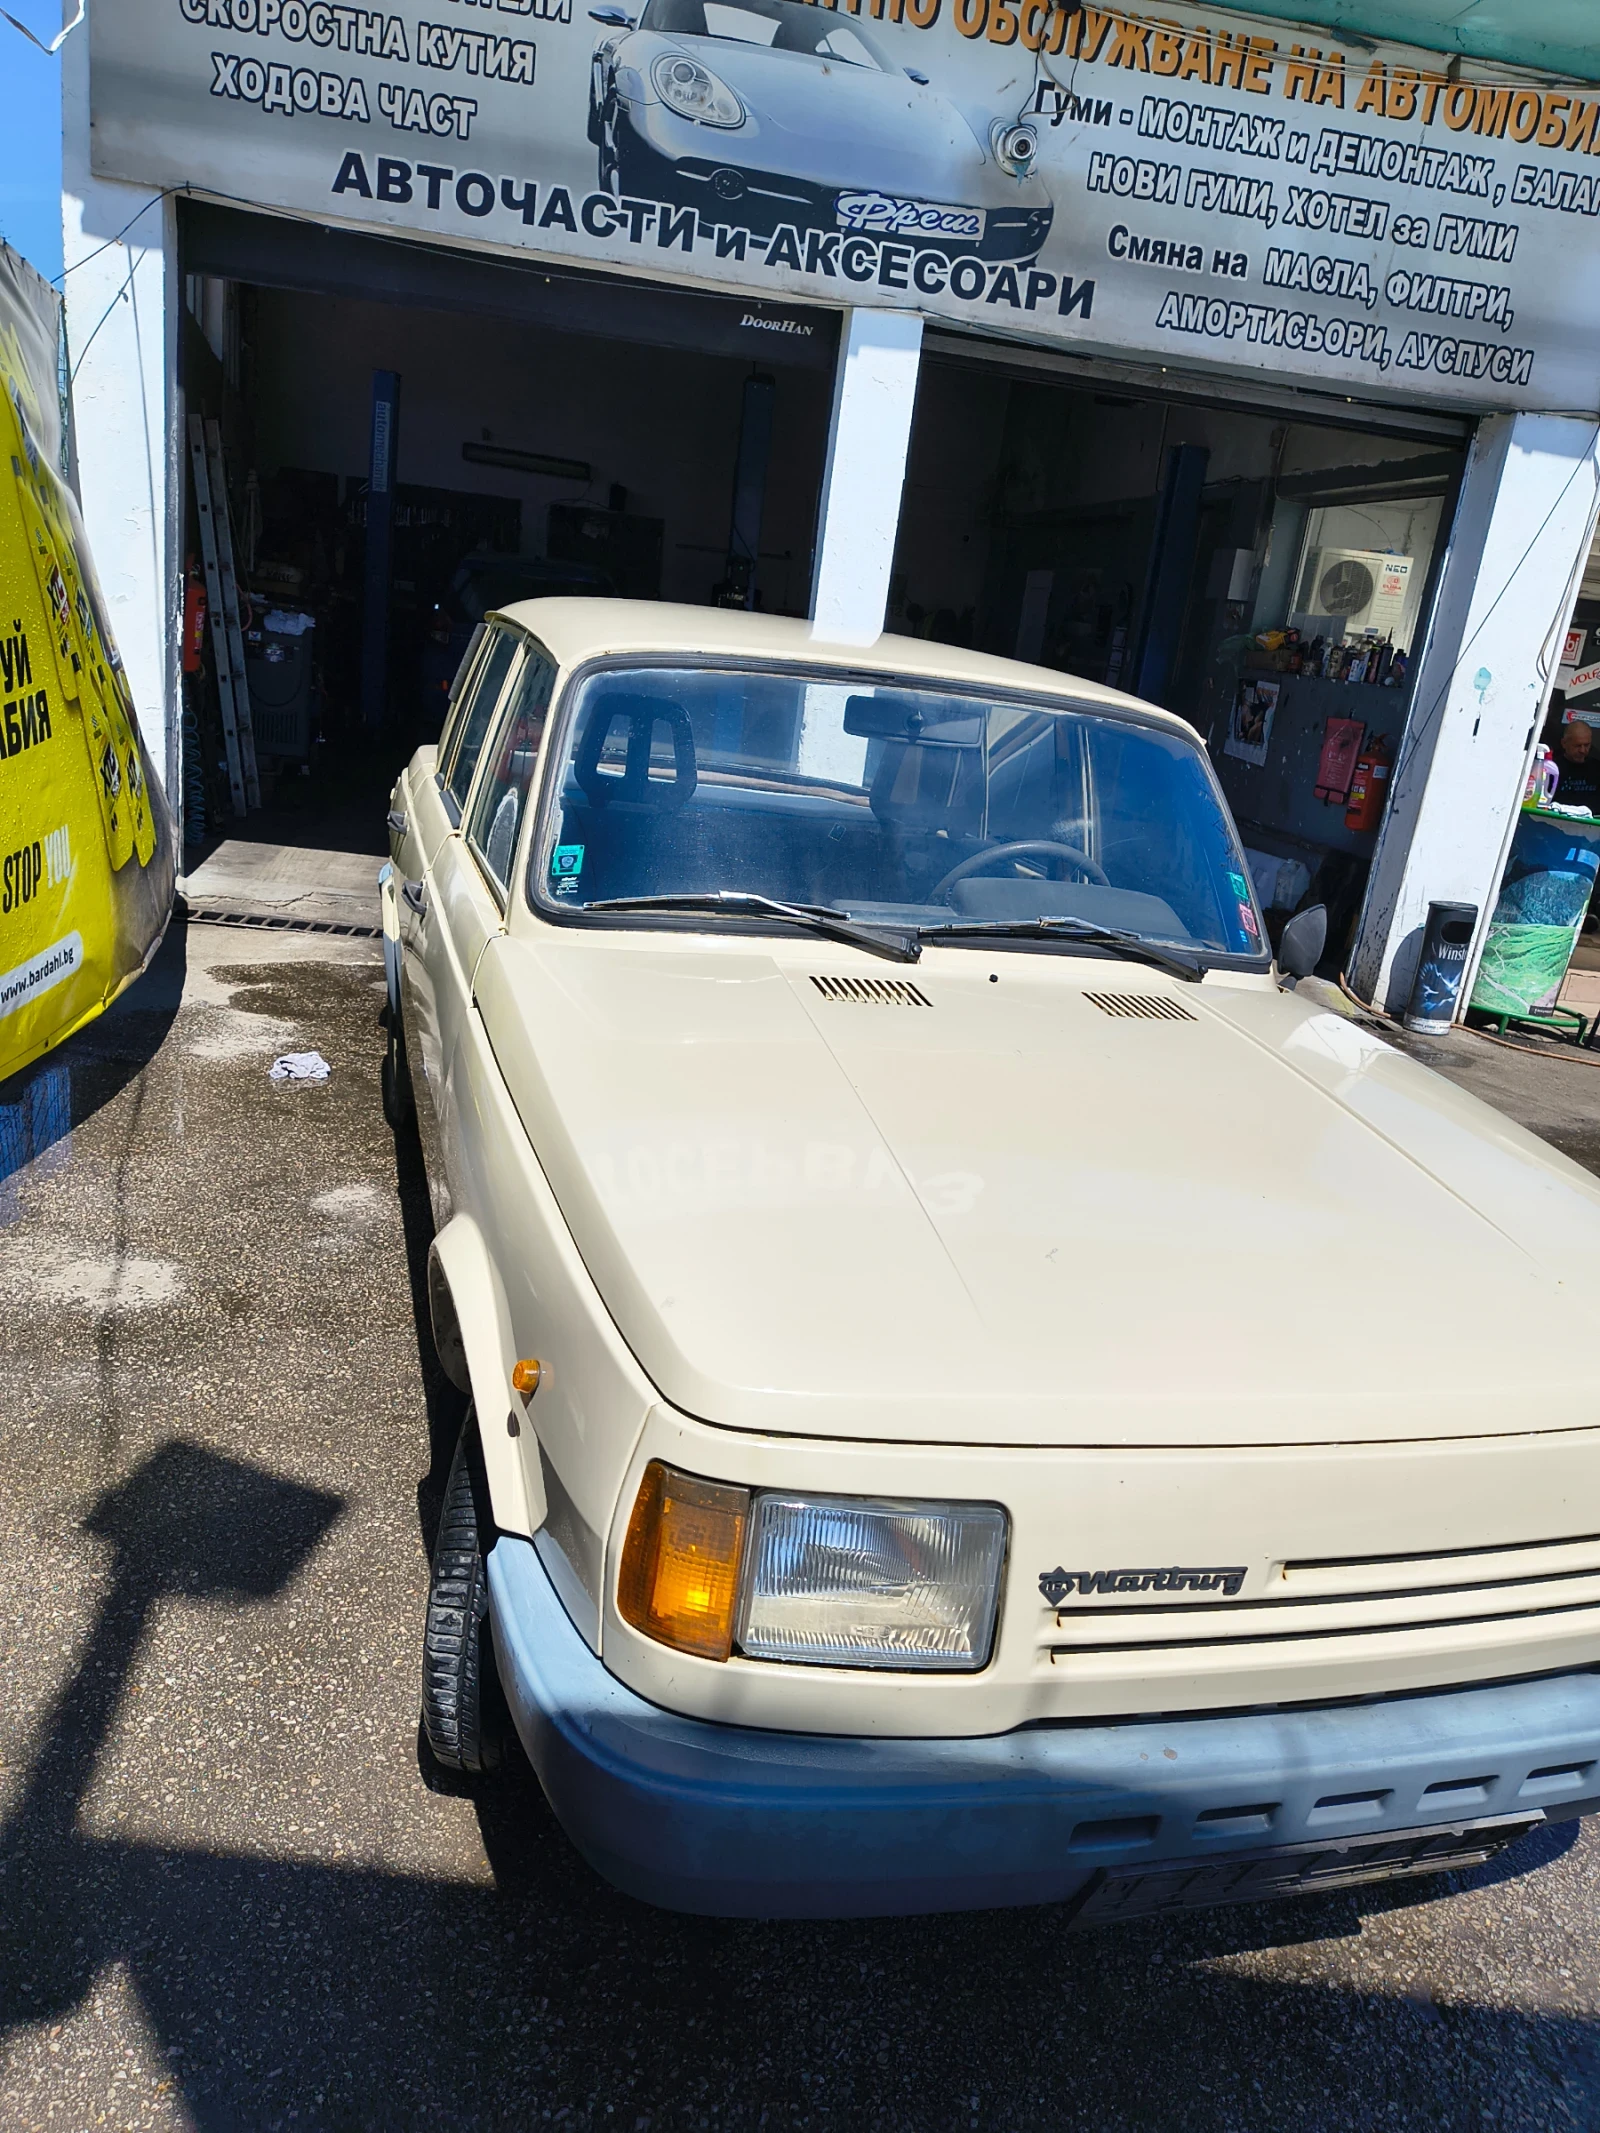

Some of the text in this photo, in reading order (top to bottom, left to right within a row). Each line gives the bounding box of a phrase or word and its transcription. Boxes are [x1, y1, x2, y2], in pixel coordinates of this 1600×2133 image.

[210, 51, 477, 141] ХОДОВА ЧАСТ
[417, 22, 537, 85] КУТИЯ
[1283, 43, 1346, 108] НА
[1353, 59, 1600, 157] АВТОМОБИ
[1034, 80, 1113, 126] Гуми
[1138, 95, 1285, 159] МОНТАЖ
[1286, 132, 1310, 163] и
[1511, 164, 1600, 217] БАЛА
[331, 151, 1096, 320] АВТОЧАСТИ и АКСЕСОАРИ
[834, 191, 981, 235] Фреш
[1087, 151, 1519, 263] НОВИ ГУМИ, ХОТЕЛ за ГУМИ
[1108, 225, 1514, 333] Смяна на МАСЛА, ФИЛТРИ,
[1156, 291, 1535, 386] АМОРТИСЬОРИ, АУСПУСИ
[2, 841, 42, 914] STOP
[0, 947, 74, 1003] www.bardahl.bg
[1438, 943, 1468, 961] Winst
[1077, 1566, 1248, 1596] Wartburg
